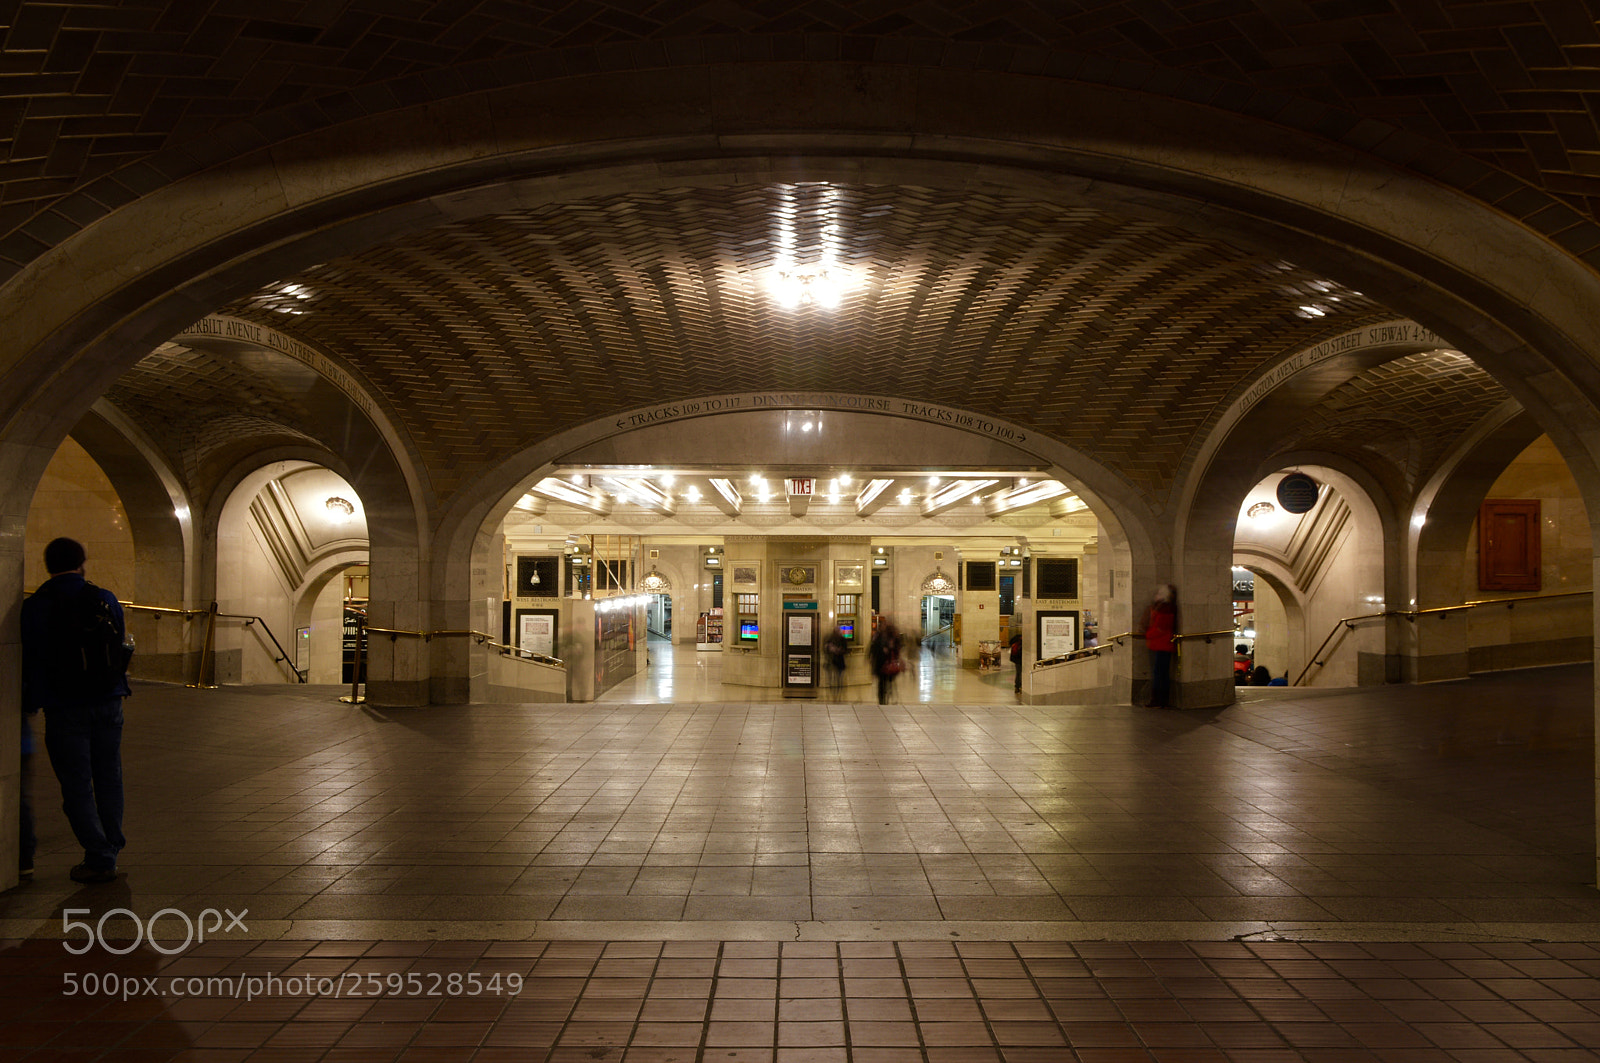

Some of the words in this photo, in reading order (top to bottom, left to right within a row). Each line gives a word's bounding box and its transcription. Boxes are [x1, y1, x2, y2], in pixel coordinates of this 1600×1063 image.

[226, 321, 262, 342] AVENUE
[268, 332, 289, 351] 42ND
[289, 343, 316, 365] STREET
[320, 359, 346, 388] SUBWAY
[346, 382, 372, 416] SHUTTLE
[1240, 374, 1275, 412] LEXINGTON
[1276, 354, 1304, 381] AVENUE
[1309, 342, 1330, 362] 42ND
[1330, 332, 1362, 354] STREET
[1369, 325, 1411, 344] SUBWAY
[628, 407, 680, 426] TRACKS
[683, 403, 700, 415] 109
[703, 399, 722, 411] TO
[725, 397, 740, 408] 117
[753, 395, 805, 406] DINING
[810, 394, 891, 410] CONCOURSE
[903, 403, 952, 421] TRACKS
[956, 414, 974, 427] 108
[975, 419, 993, 433] TO
[996, 427, 1014, 440] 100
